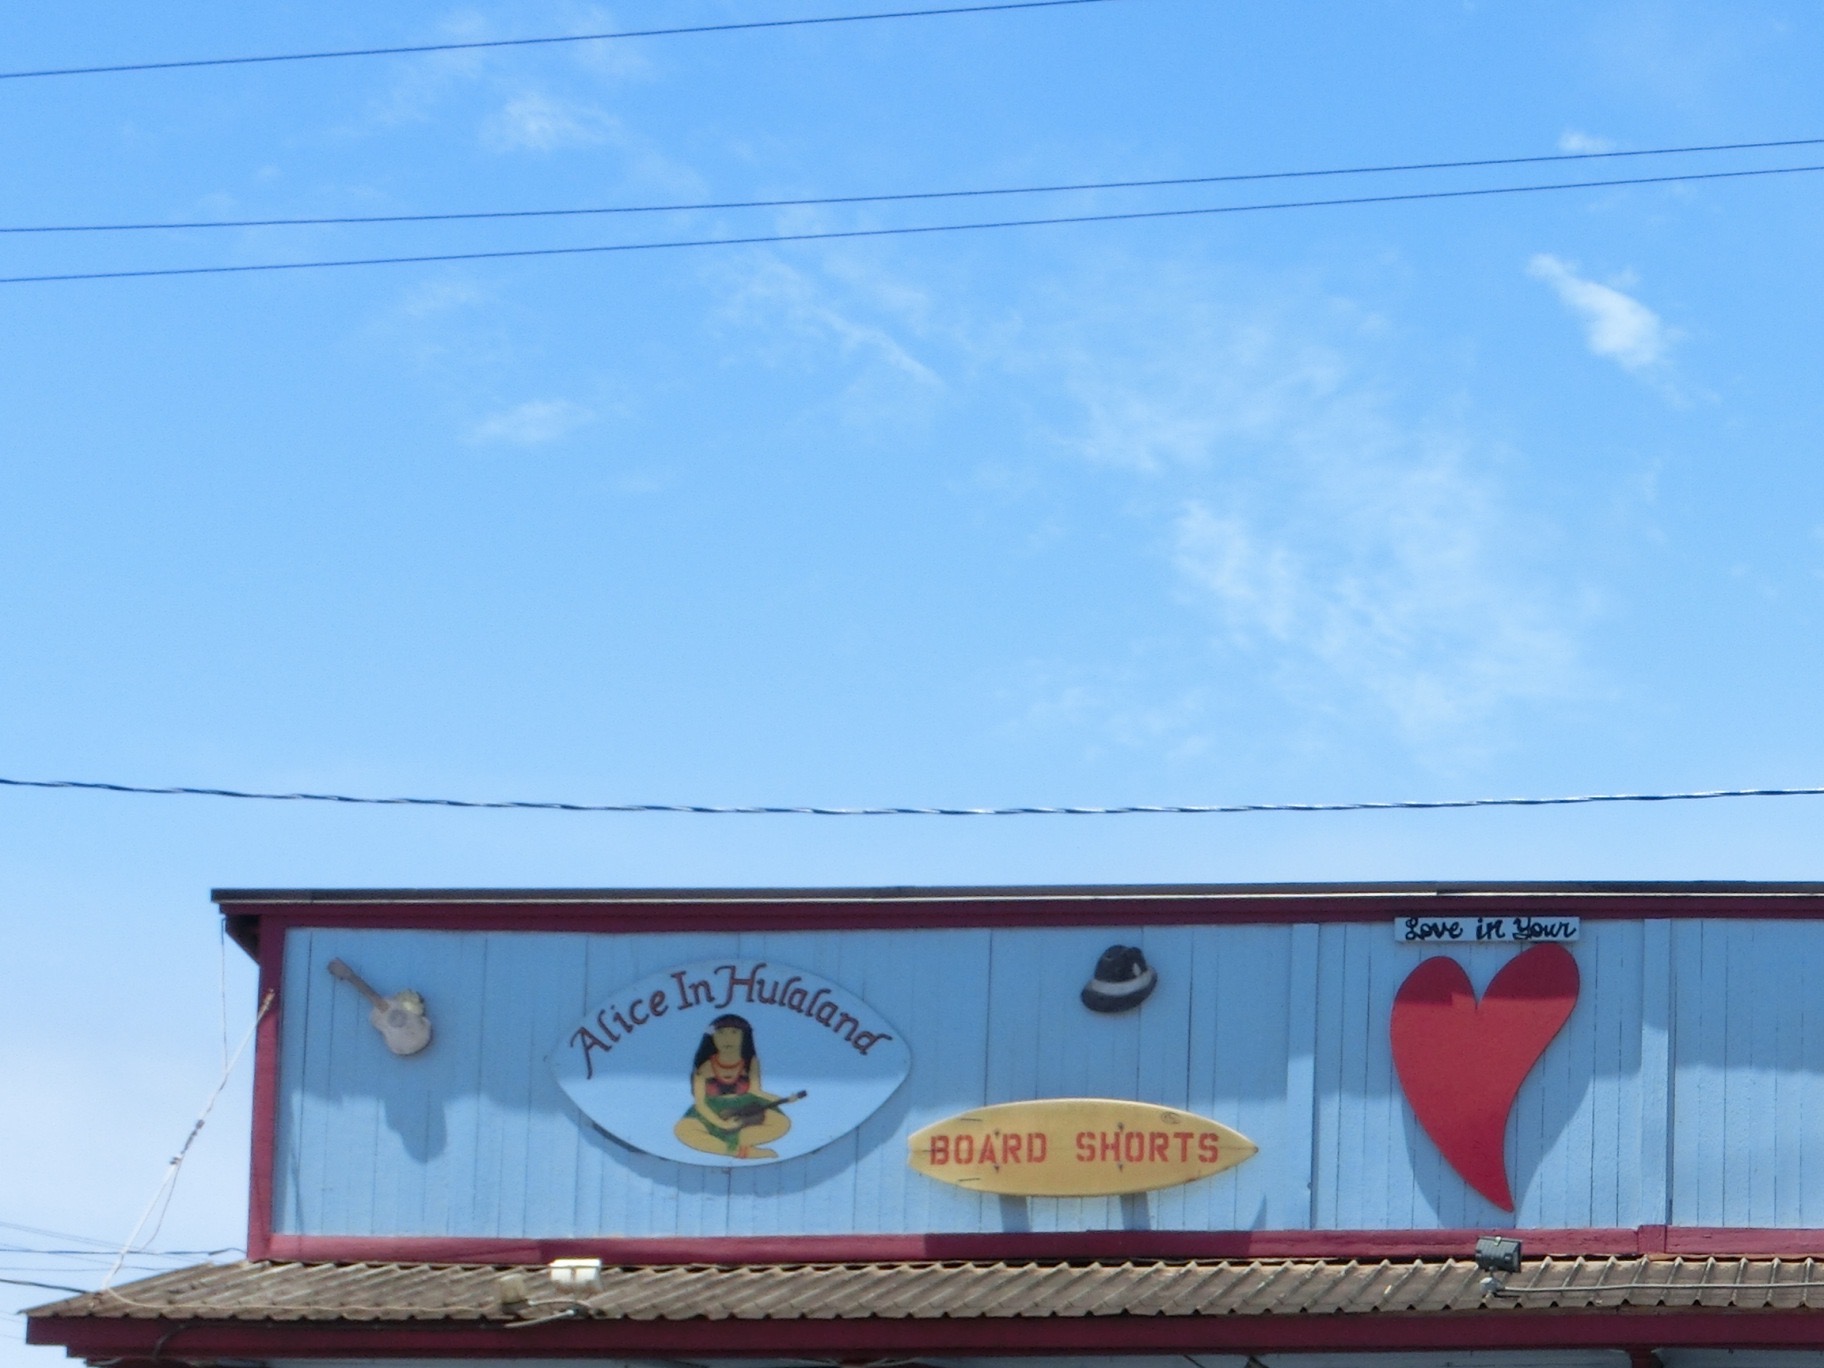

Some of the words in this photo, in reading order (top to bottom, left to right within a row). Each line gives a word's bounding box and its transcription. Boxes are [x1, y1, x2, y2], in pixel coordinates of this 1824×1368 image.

[1405, 917, 1463, 941] Love
[1476, 917, 1505, 940] in
[1512, 917, 1577, 940] Your
[569, 988, 669, 1080] Alice
[670, 970, 716, 1011] In
[714, 962, 893, 1055] Hulaland
[929, 1132, 1048, 1166] BOARD
[1075, 1131, 1220, 1163] SHORTS
